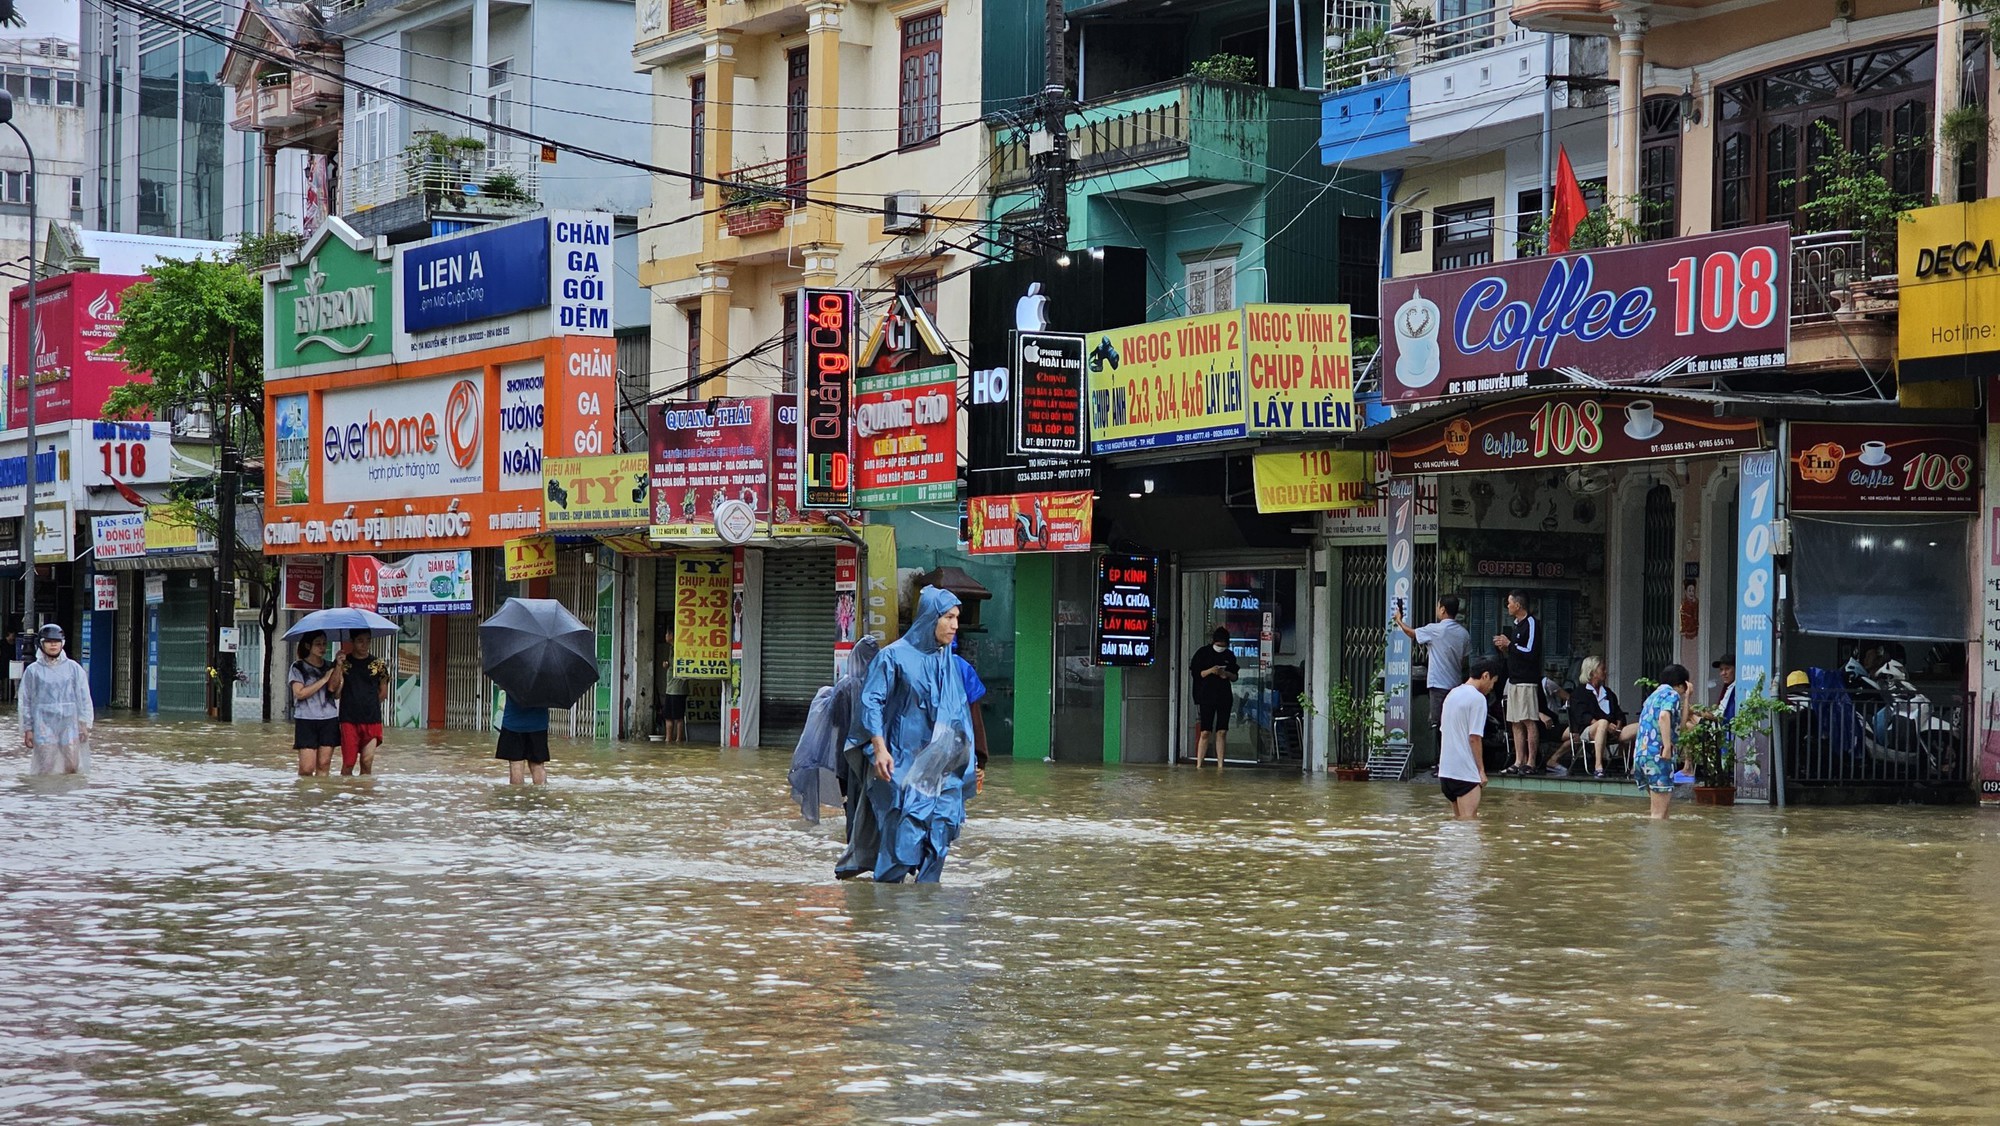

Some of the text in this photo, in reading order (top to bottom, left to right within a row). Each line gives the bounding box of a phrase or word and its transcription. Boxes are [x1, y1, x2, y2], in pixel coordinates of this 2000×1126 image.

[556, 220, 609, 245] CHĂN
[568, 251, 600, 273] GA
[1916, 239, 2000, 277] DECA
[419, 258, 462, 291] LIEN
[563, 275, 603, 301] GỐI
[294, 285, 375, 334] EVERON
[560, 306, 608, 331] ĐỆM
[1454, 245, 1779, 371] Coffee 108
[1249, 308, 1347, 350] NGỌC VĨNH 2
[1932, 325, 1997, 344] Hotline:
[1040, 349, 1062, 357] IPHONE
[1122, 320, 1239, 367] NGỌC VĨNH 2
[569, 348, 612, 377] CHĂN
[809, 295, 848, 439] Quảng Cáo
[1039, 357, 1080, 369] HOÀI LINH
[1250, 344, 1350, 397] CHỤP ẢNH
[1709, 359, 1721, 370] 414
[1182, 370, 1203, 417] 4x6
[1462, 380, 1476, 392] 108
[501, 395, 544, 431] TƯỜNG
[578, 392, 601, 415] GA
[666, 401, 752, 431] QUANG THÁI
[856, 387, 949, 438] QUẢNG CÁO
[1253, 391, 1351, 428] LẤY LIỀN
[325, 408, 440, 462] everhome
[574, 420, 602, 455] GỐI
[697, 429, 720, 438] Flowers
[1530, 399, 1604, 458] 108
[503, 440, 541, 474] NGÂN
[1482, 431, 1529, 459] Coffee
[100, 442, 146, 477] 118
[426, 462, 440, 475] hoa
[808, 453, 850, 490] LED
[1300, 451, 1331, 477] 110
[1744, 457, 1773, 478] Coffee
[1902, 452, 1974, 491] 108
[569, 469, 625, 505] TÝ
[1849, 469, 1895, 488] Coffee
[1262, 477, 1332, 507] NGUYỄN
[97, 517, 117, 529] BÁN
[392, 503, 425, 540] HÀN
[425, 498, 471, 538] QUỐC
[680, 559, 728, 574] TÝ
[1109, 566, 1147, 583] ÉP KÍNH
[1478, 560, 1565, 577] COFFEE 108
[678, 575, 730, 589] CHỤP ẢNH
[98, 600, 115, 609] Pin
[678, 588, 728, 609] 2x3
[1103, 590, 1150, 608] SỬA CHỮA
[678, 608, 728, 628] 3x4
[1104, 616, 1148, 631] LẤY NGAY
[1741, 614, 1766, 630] COFFEE
[678, 628, 728, 648] 4x6
[1101, 642, 1149, 657] BÁN TRẢ GÓP
[677, 657, 694, 667] ÉP
[677, 667, 728, 676] PLASTIC
[1390, 705, 1405, 720] 100%
